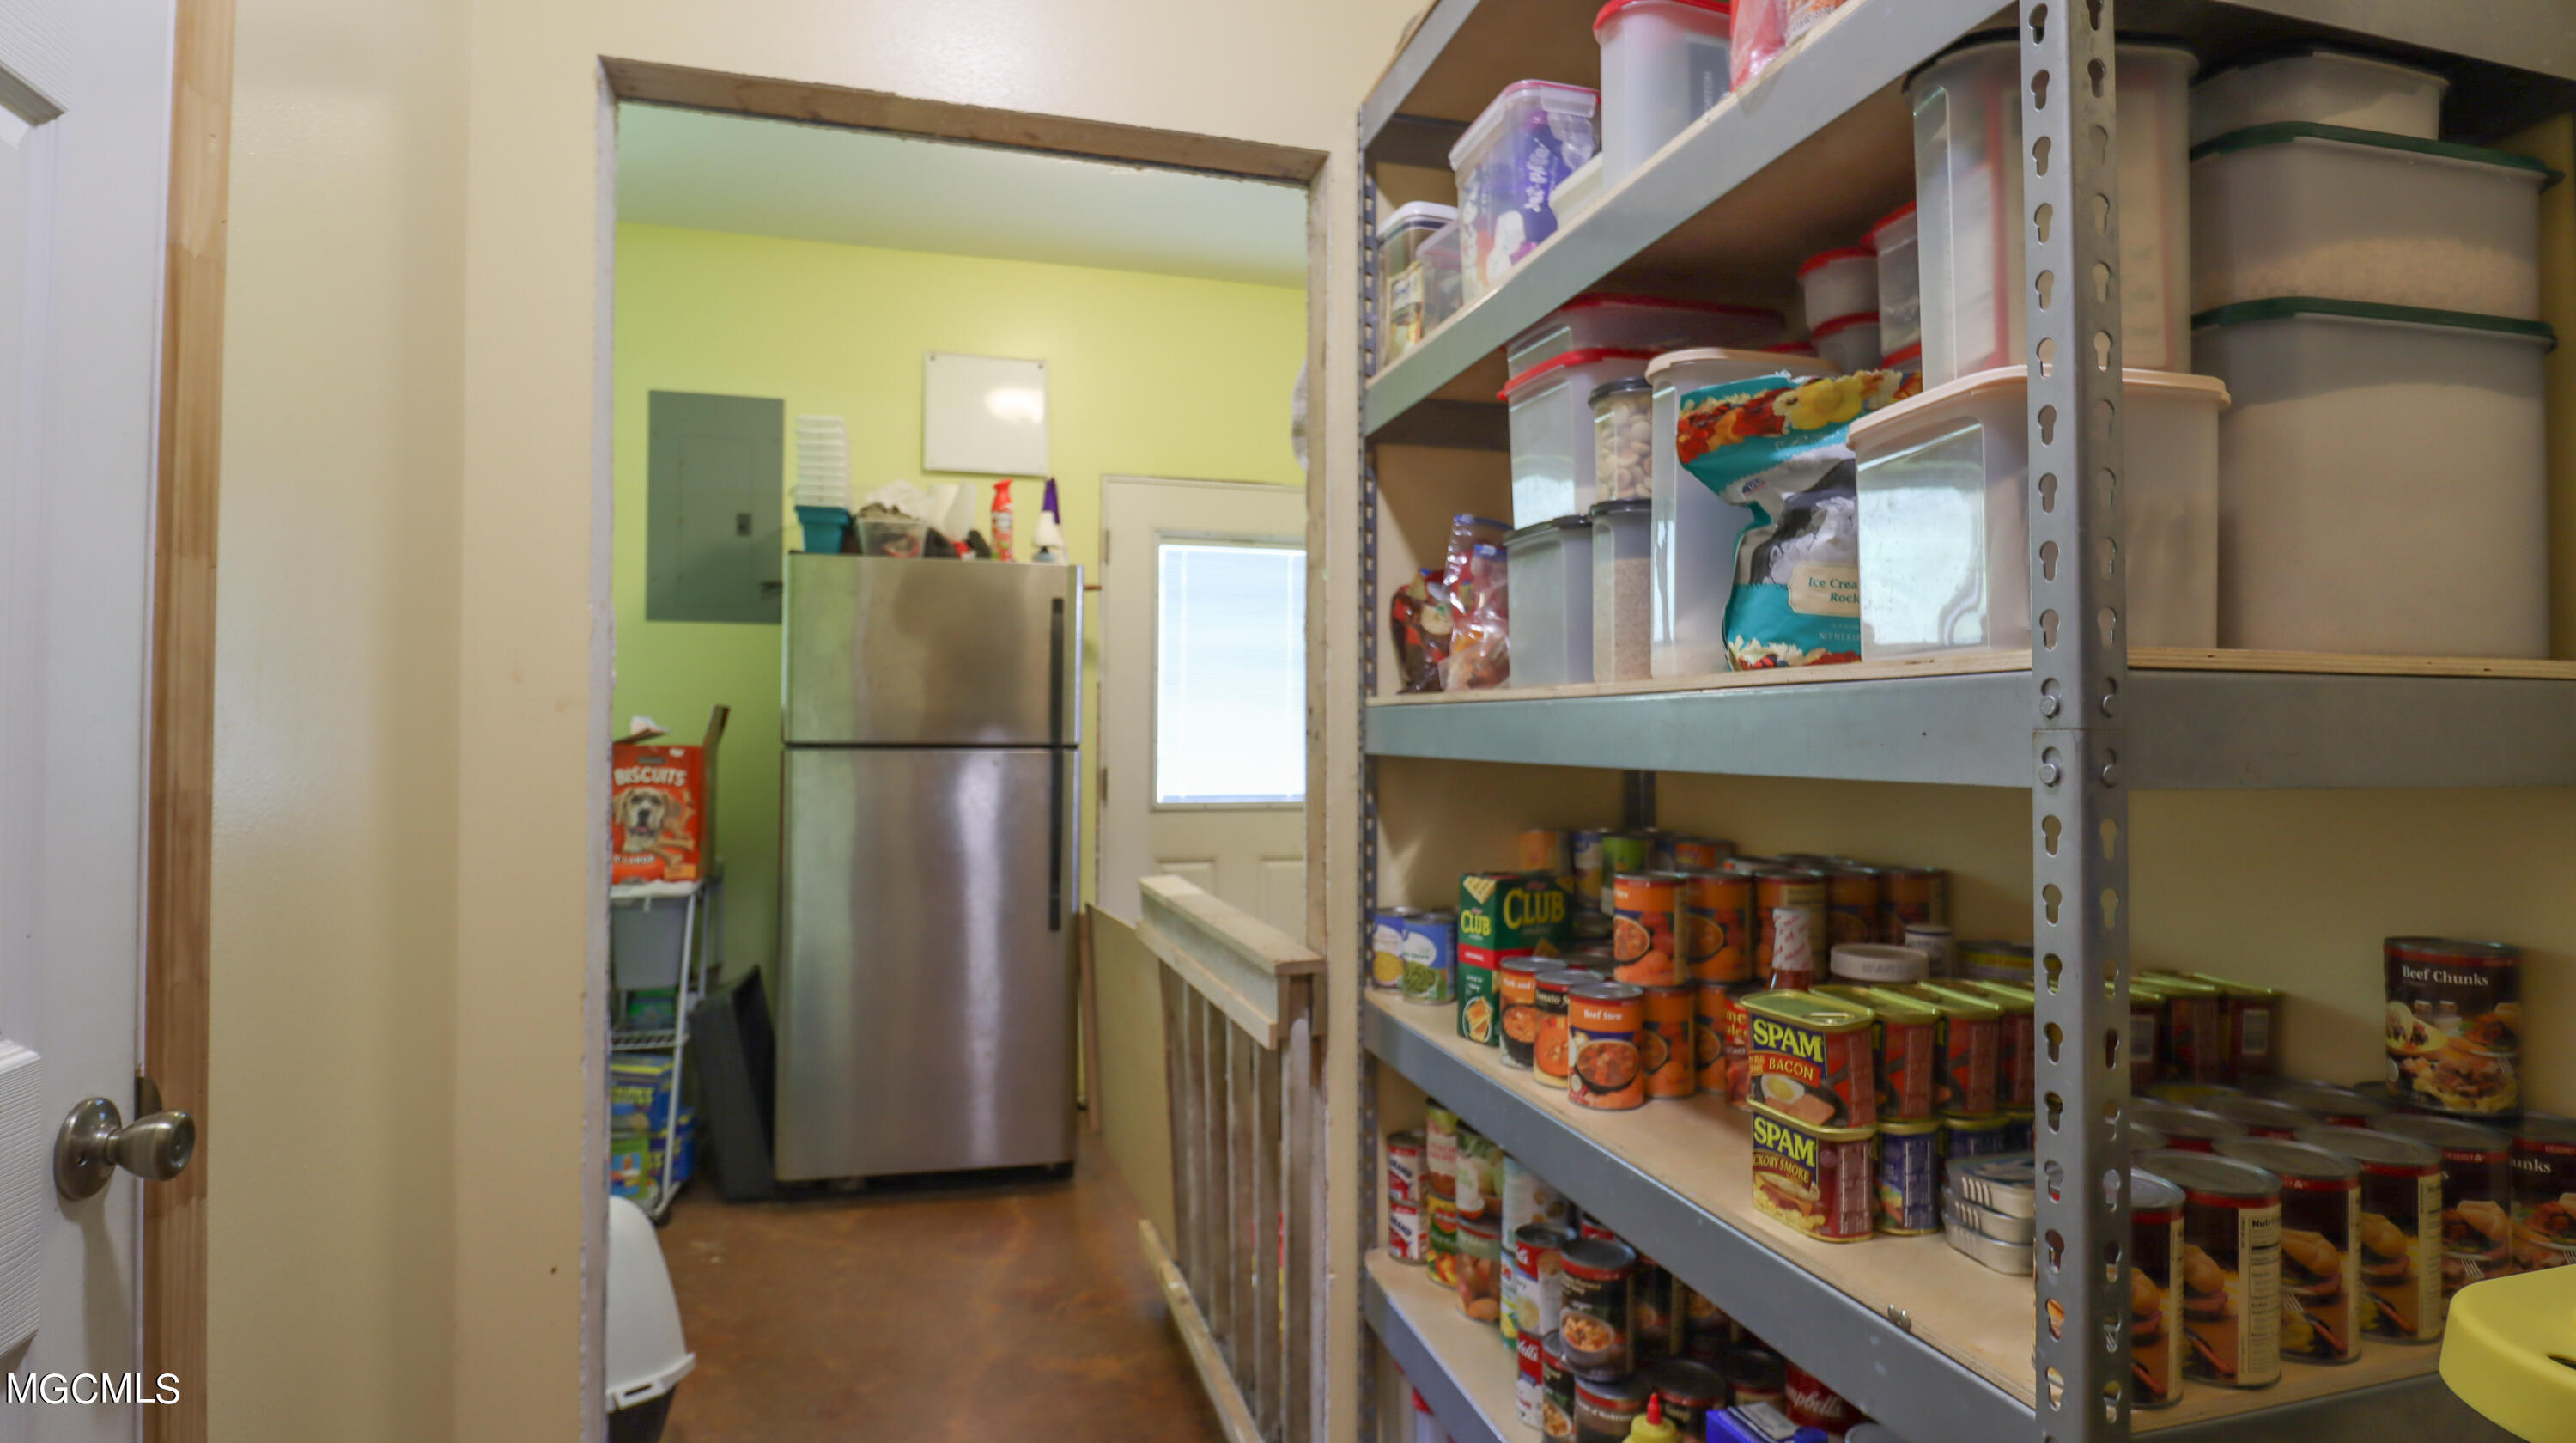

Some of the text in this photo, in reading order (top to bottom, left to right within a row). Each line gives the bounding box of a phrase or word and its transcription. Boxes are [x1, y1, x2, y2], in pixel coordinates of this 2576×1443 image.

[1808, 576, 1859, 590] Ice Crea
[613, 766, 687, 788] BISCUITS
[1503, 888, 1566, 930] CLUB
[1461, 910, 1492, 936] CLUB
[2403, 965, 2489, 986] Beef Chunks
[1583, 1008, 1623, 1021] Beef Stew
[1753, 1017, 1824, 1063] SPAM
[1769, 1056, 1814, 1081] BACON
[1753, 1116, 1817, 1168] SPAM
[1753, 1153, 1810, 1182] CKORY SMOKE
[2509, 1157, 2552, 1173] unks
